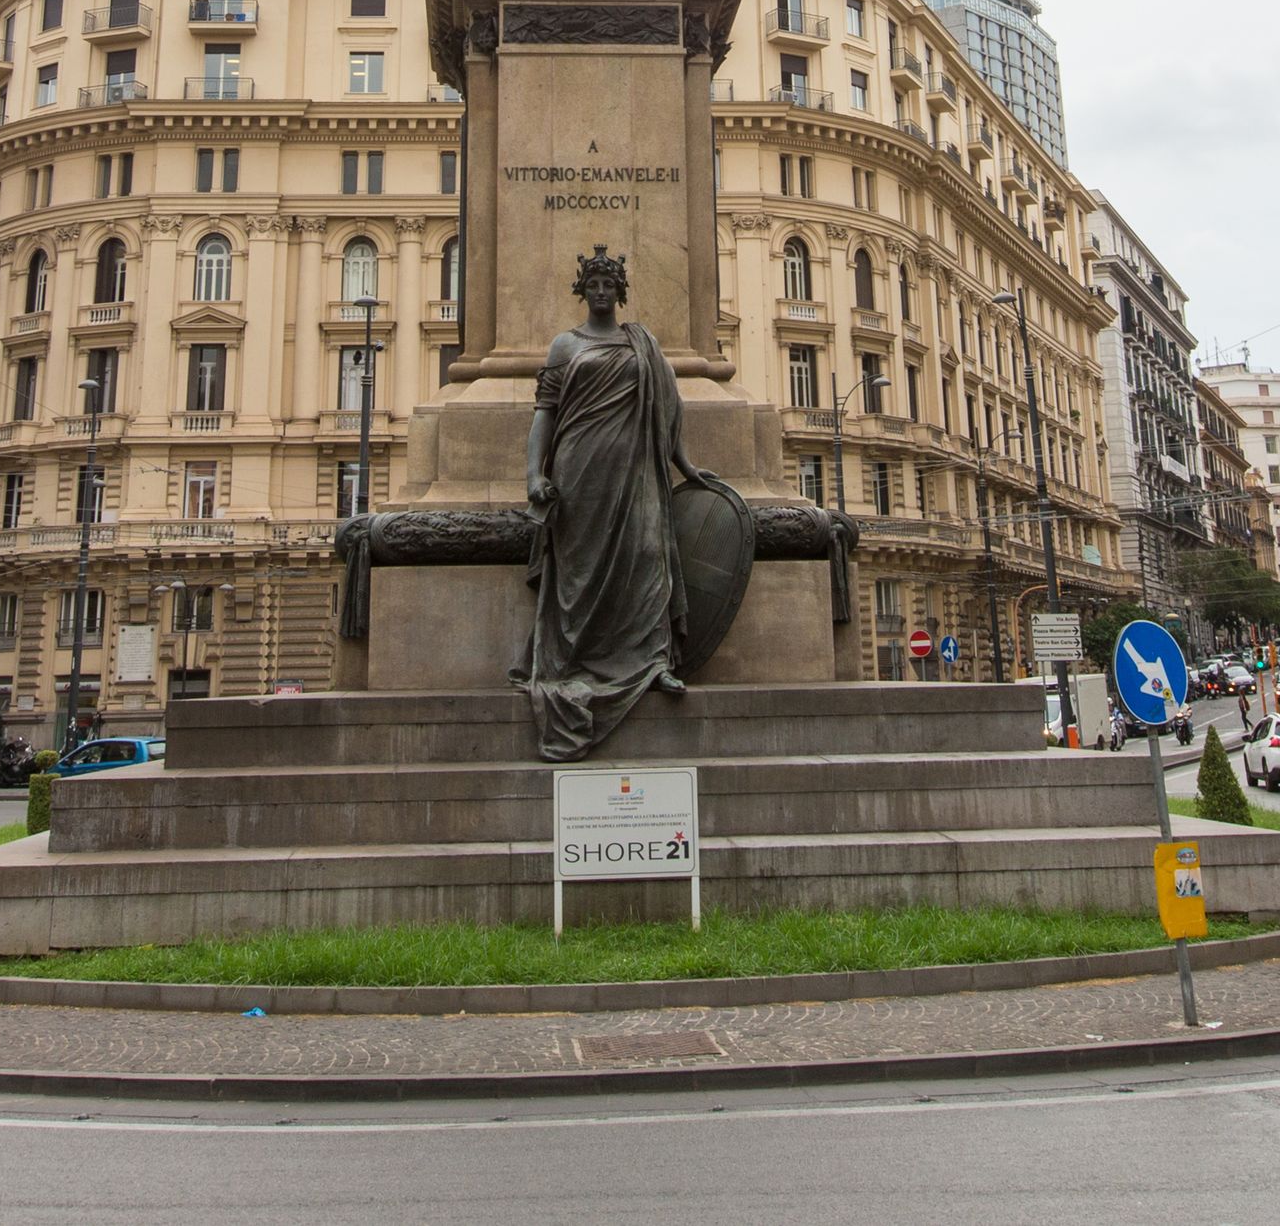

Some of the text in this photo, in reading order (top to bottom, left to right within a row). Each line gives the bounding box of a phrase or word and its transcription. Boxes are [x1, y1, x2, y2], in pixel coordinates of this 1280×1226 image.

[587, 139, 599, 154] A
[504, 167, 576, 183] VITTORIO
[564, 841, 690, 863] SHORE21
